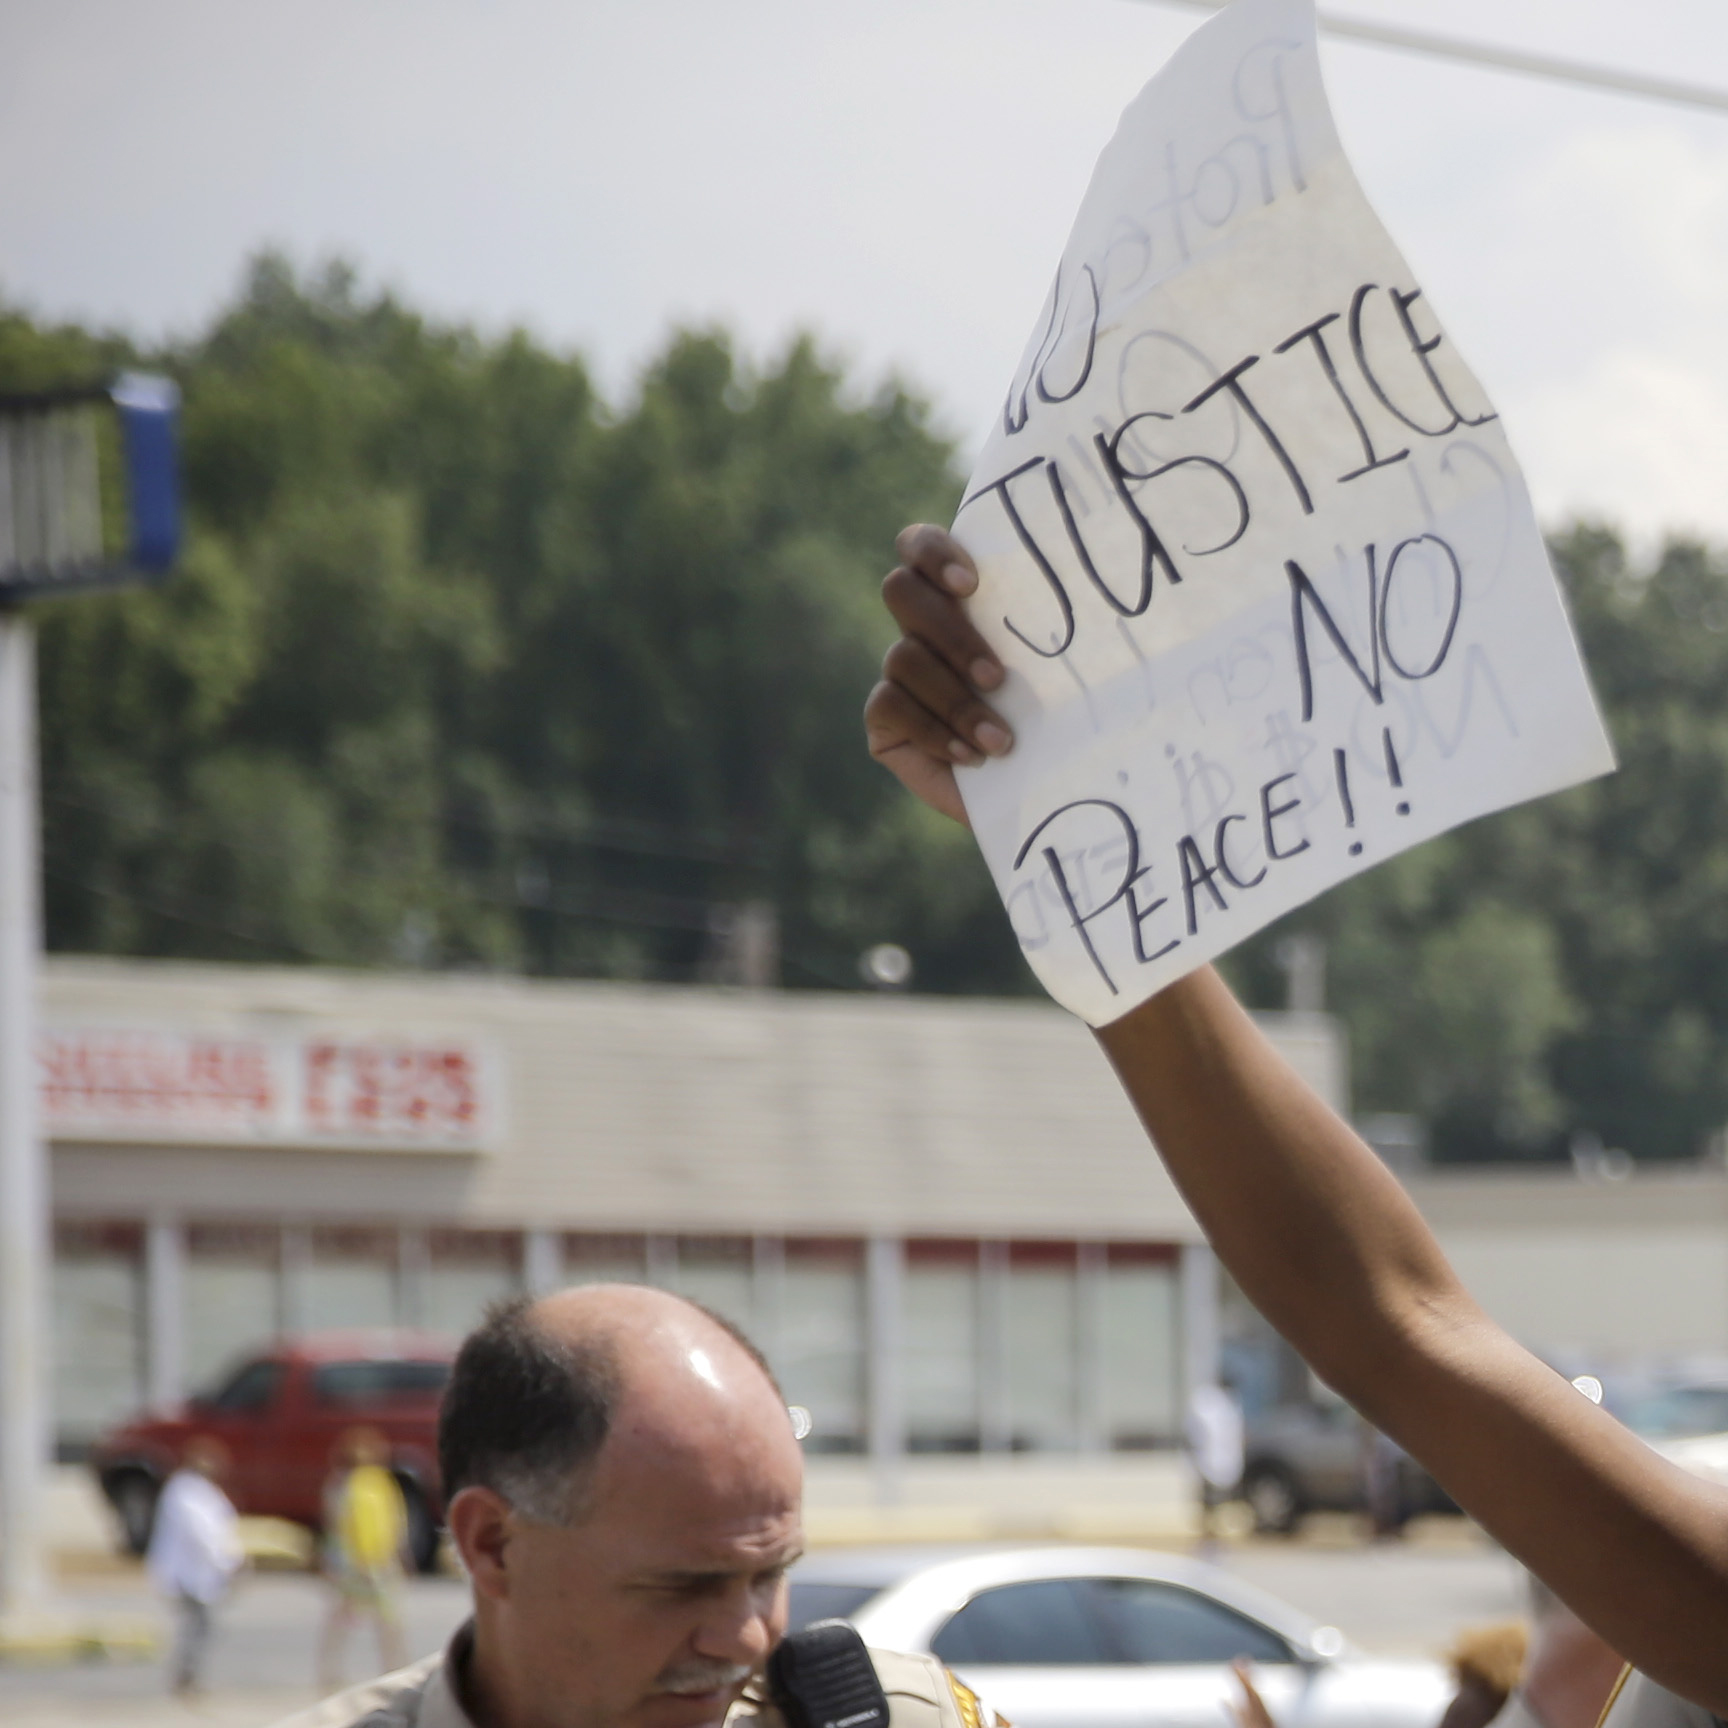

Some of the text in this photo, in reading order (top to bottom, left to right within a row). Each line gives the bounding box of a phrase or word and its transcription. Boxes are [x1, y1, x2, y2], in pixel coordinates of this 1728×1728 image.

[955, 283, 1499, 659] JUSTICE
[1285, 533, 1464, 722] NO
[1013, 727, 1412, 996] PEACE!!
